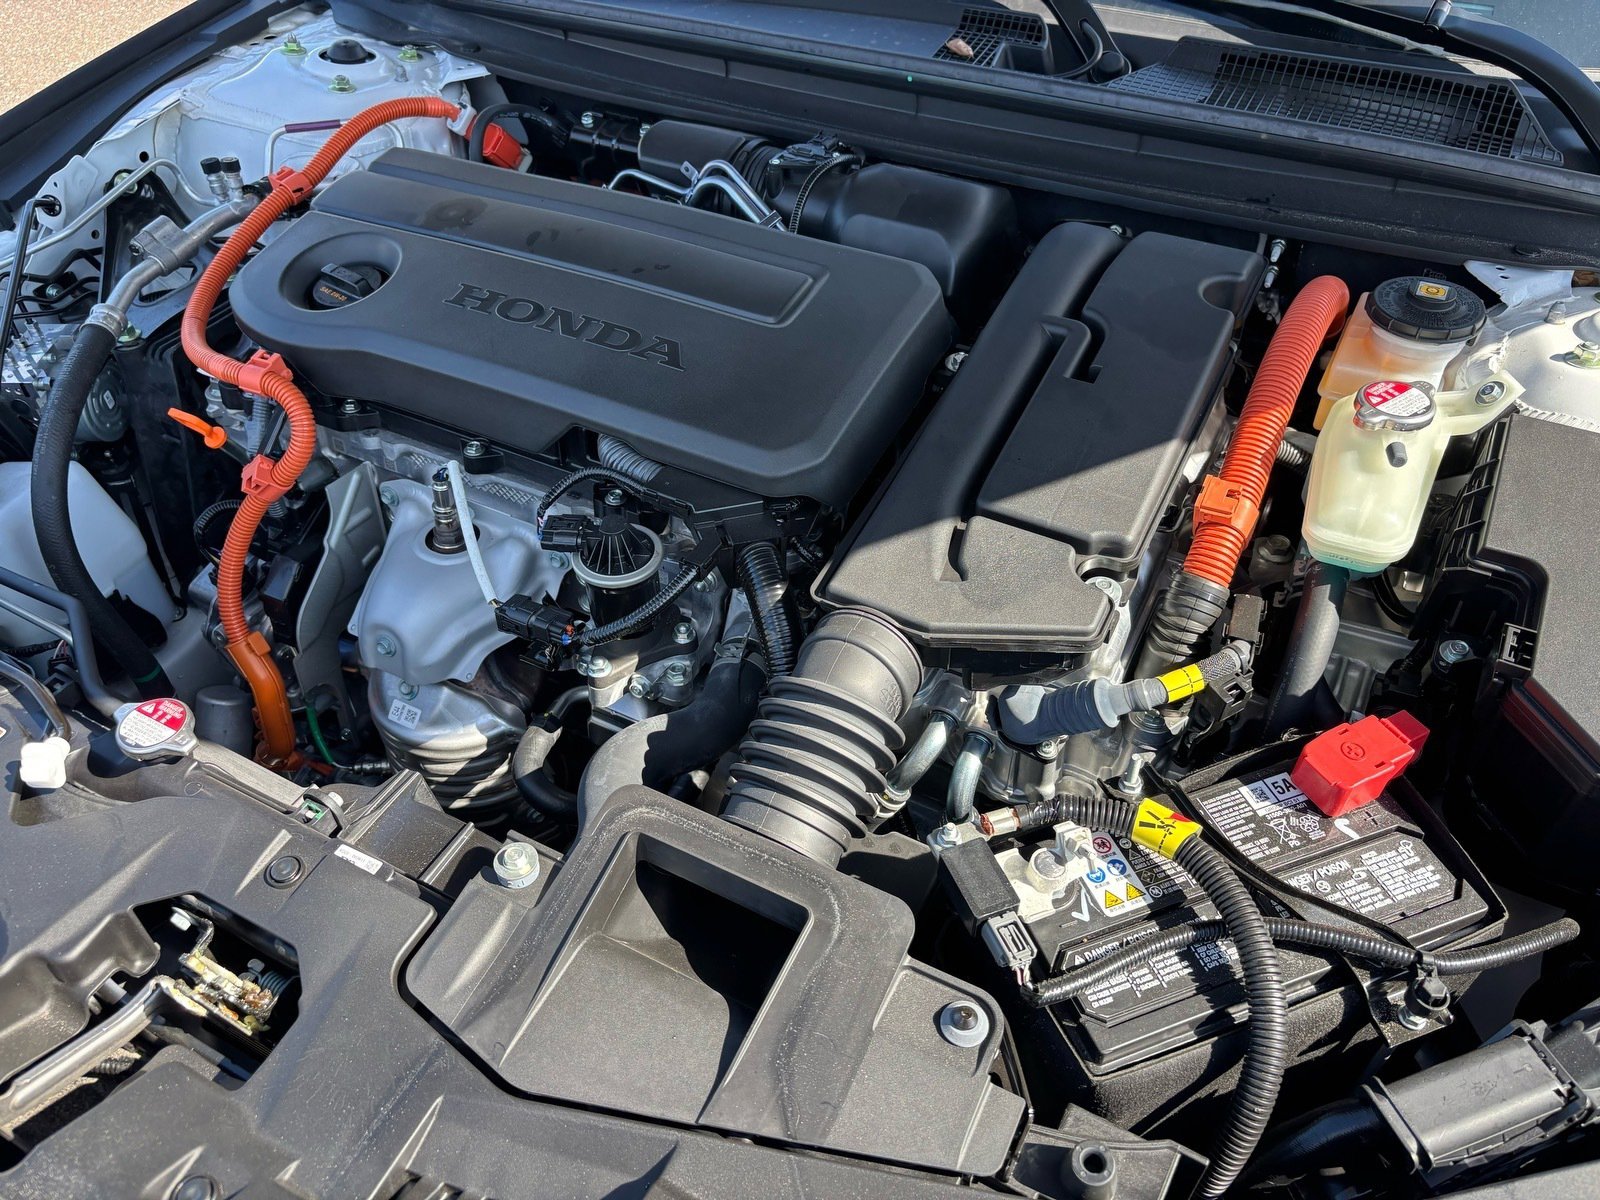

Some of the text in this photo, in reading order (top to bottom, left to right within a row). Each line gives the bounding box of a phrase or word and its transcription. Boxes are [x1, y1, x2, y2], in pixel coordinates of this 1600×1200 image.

[442, 283, 687, 372] HONDA
[1271, 778, 1297, 795] 5A
[1284, 873, 1313, 888] NGER
[1318, 861, 1350, 877] POISON
[1085, 942, 1120, 960] DANGER
